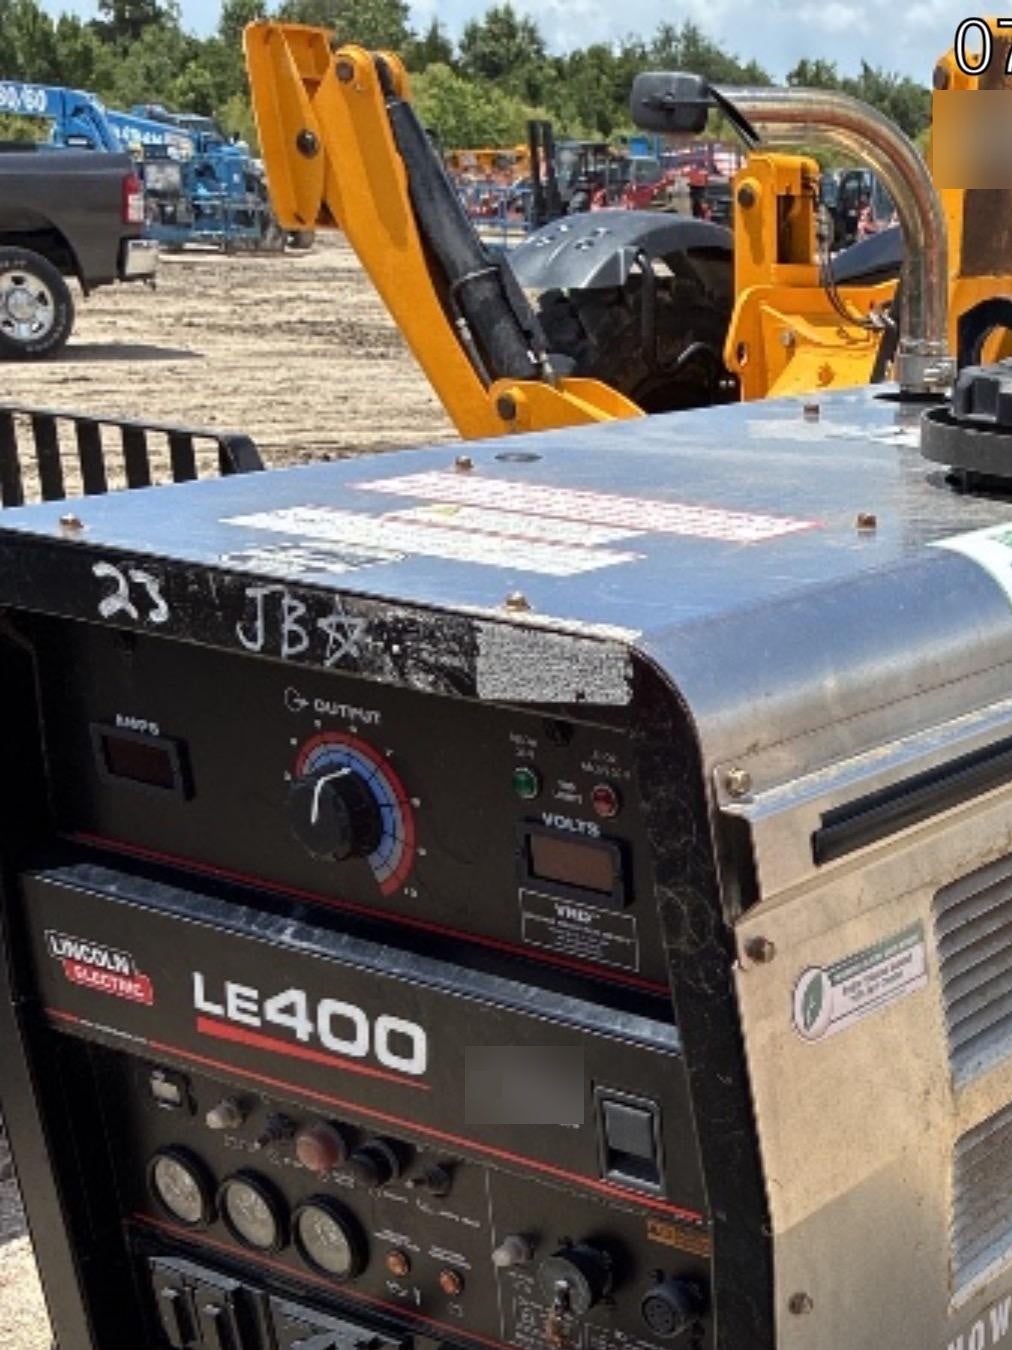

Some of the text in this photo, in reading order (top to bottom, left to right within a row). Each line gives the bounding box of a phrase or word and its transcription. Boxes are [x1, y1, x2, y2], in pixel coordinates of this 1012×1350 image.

[92, 563, 309, 661] 23 JB
[314, 698, 382, 725] OUTPUT
[542, 812, 600, 838] VOLTS
[50, 935, 131, 976] LINCOLN
[74, 965, 145, 998] ELECTRIC
[192, 971, 428, 1076] LE400
